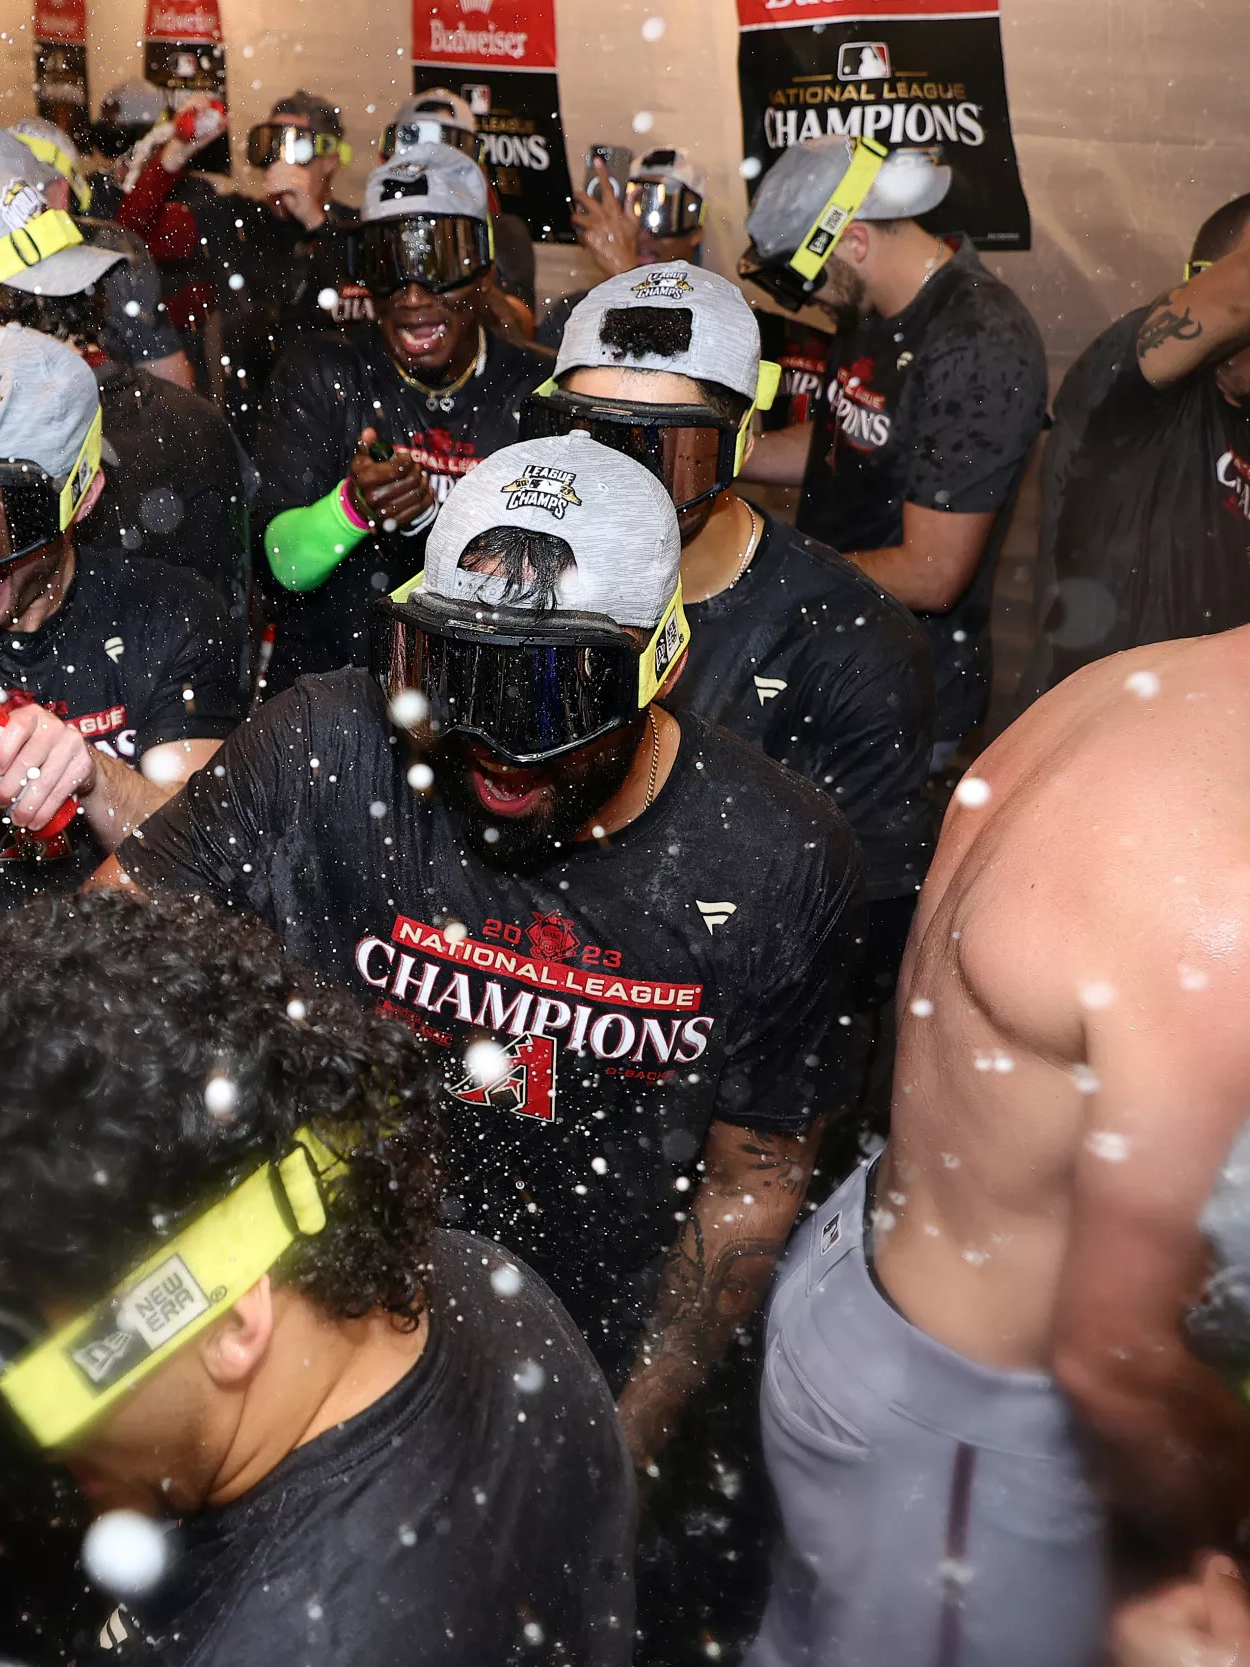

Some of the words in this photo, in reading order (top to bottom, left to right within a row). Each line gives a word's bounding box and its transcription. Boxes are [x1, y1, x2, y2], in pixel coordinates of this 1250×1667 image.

[429, 18, 528, 59] Budweiser
[883, 80, 967, 101] LEAGUE
[764, 102, 985, 149] CHAMPIONS
[524, 465, 577, 485] LEAGUE
[506, 490, 569, 520] CHAMPS
[399, 922, 558, 986] NATIONAL
[565, 977, 695, 1007] LEAGUE
[482, 918, 523, 946] 20
[582, 944, 622, 968] 23
[354, 935, 716, 1065] CHAMPIONS
[134, 1272, 184, 1319] NEW
[145, 1287, 195, 1333] ERA
